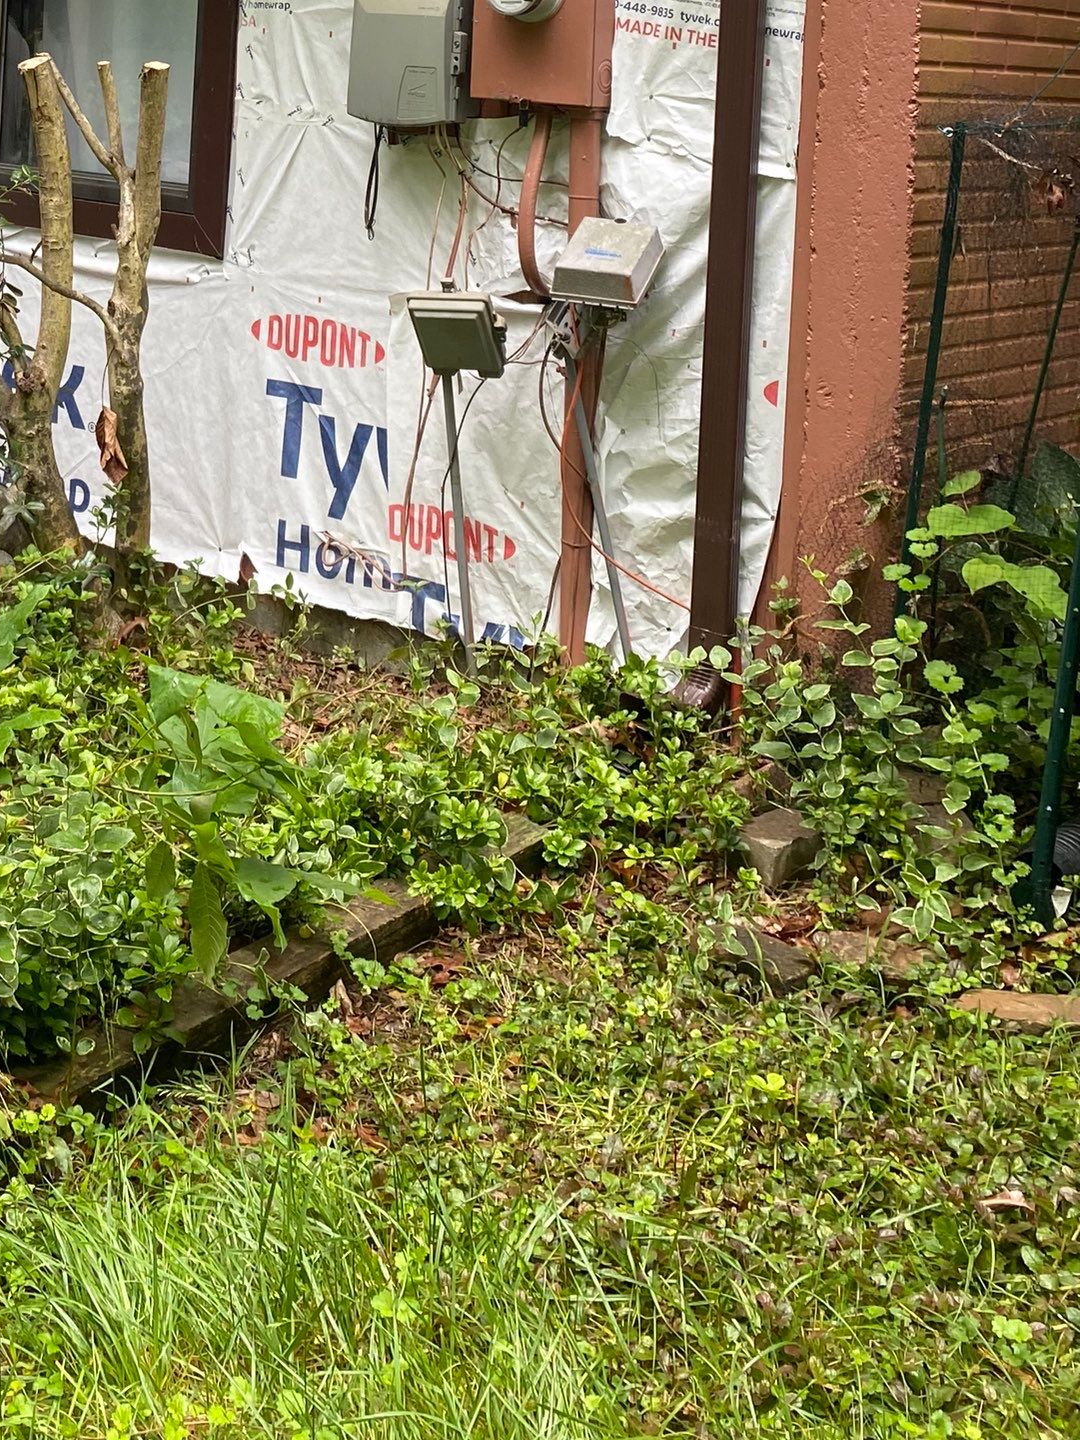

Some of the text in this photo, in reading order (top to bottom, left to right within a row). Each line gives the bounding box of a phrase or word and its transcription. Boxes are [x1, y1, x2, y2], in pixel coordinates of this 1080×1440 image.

[615, 16, 718, 49] MADE IN THE
[266, 314, 371, 369] DUPONT
[388, 504, 499, 563] DUPONT
